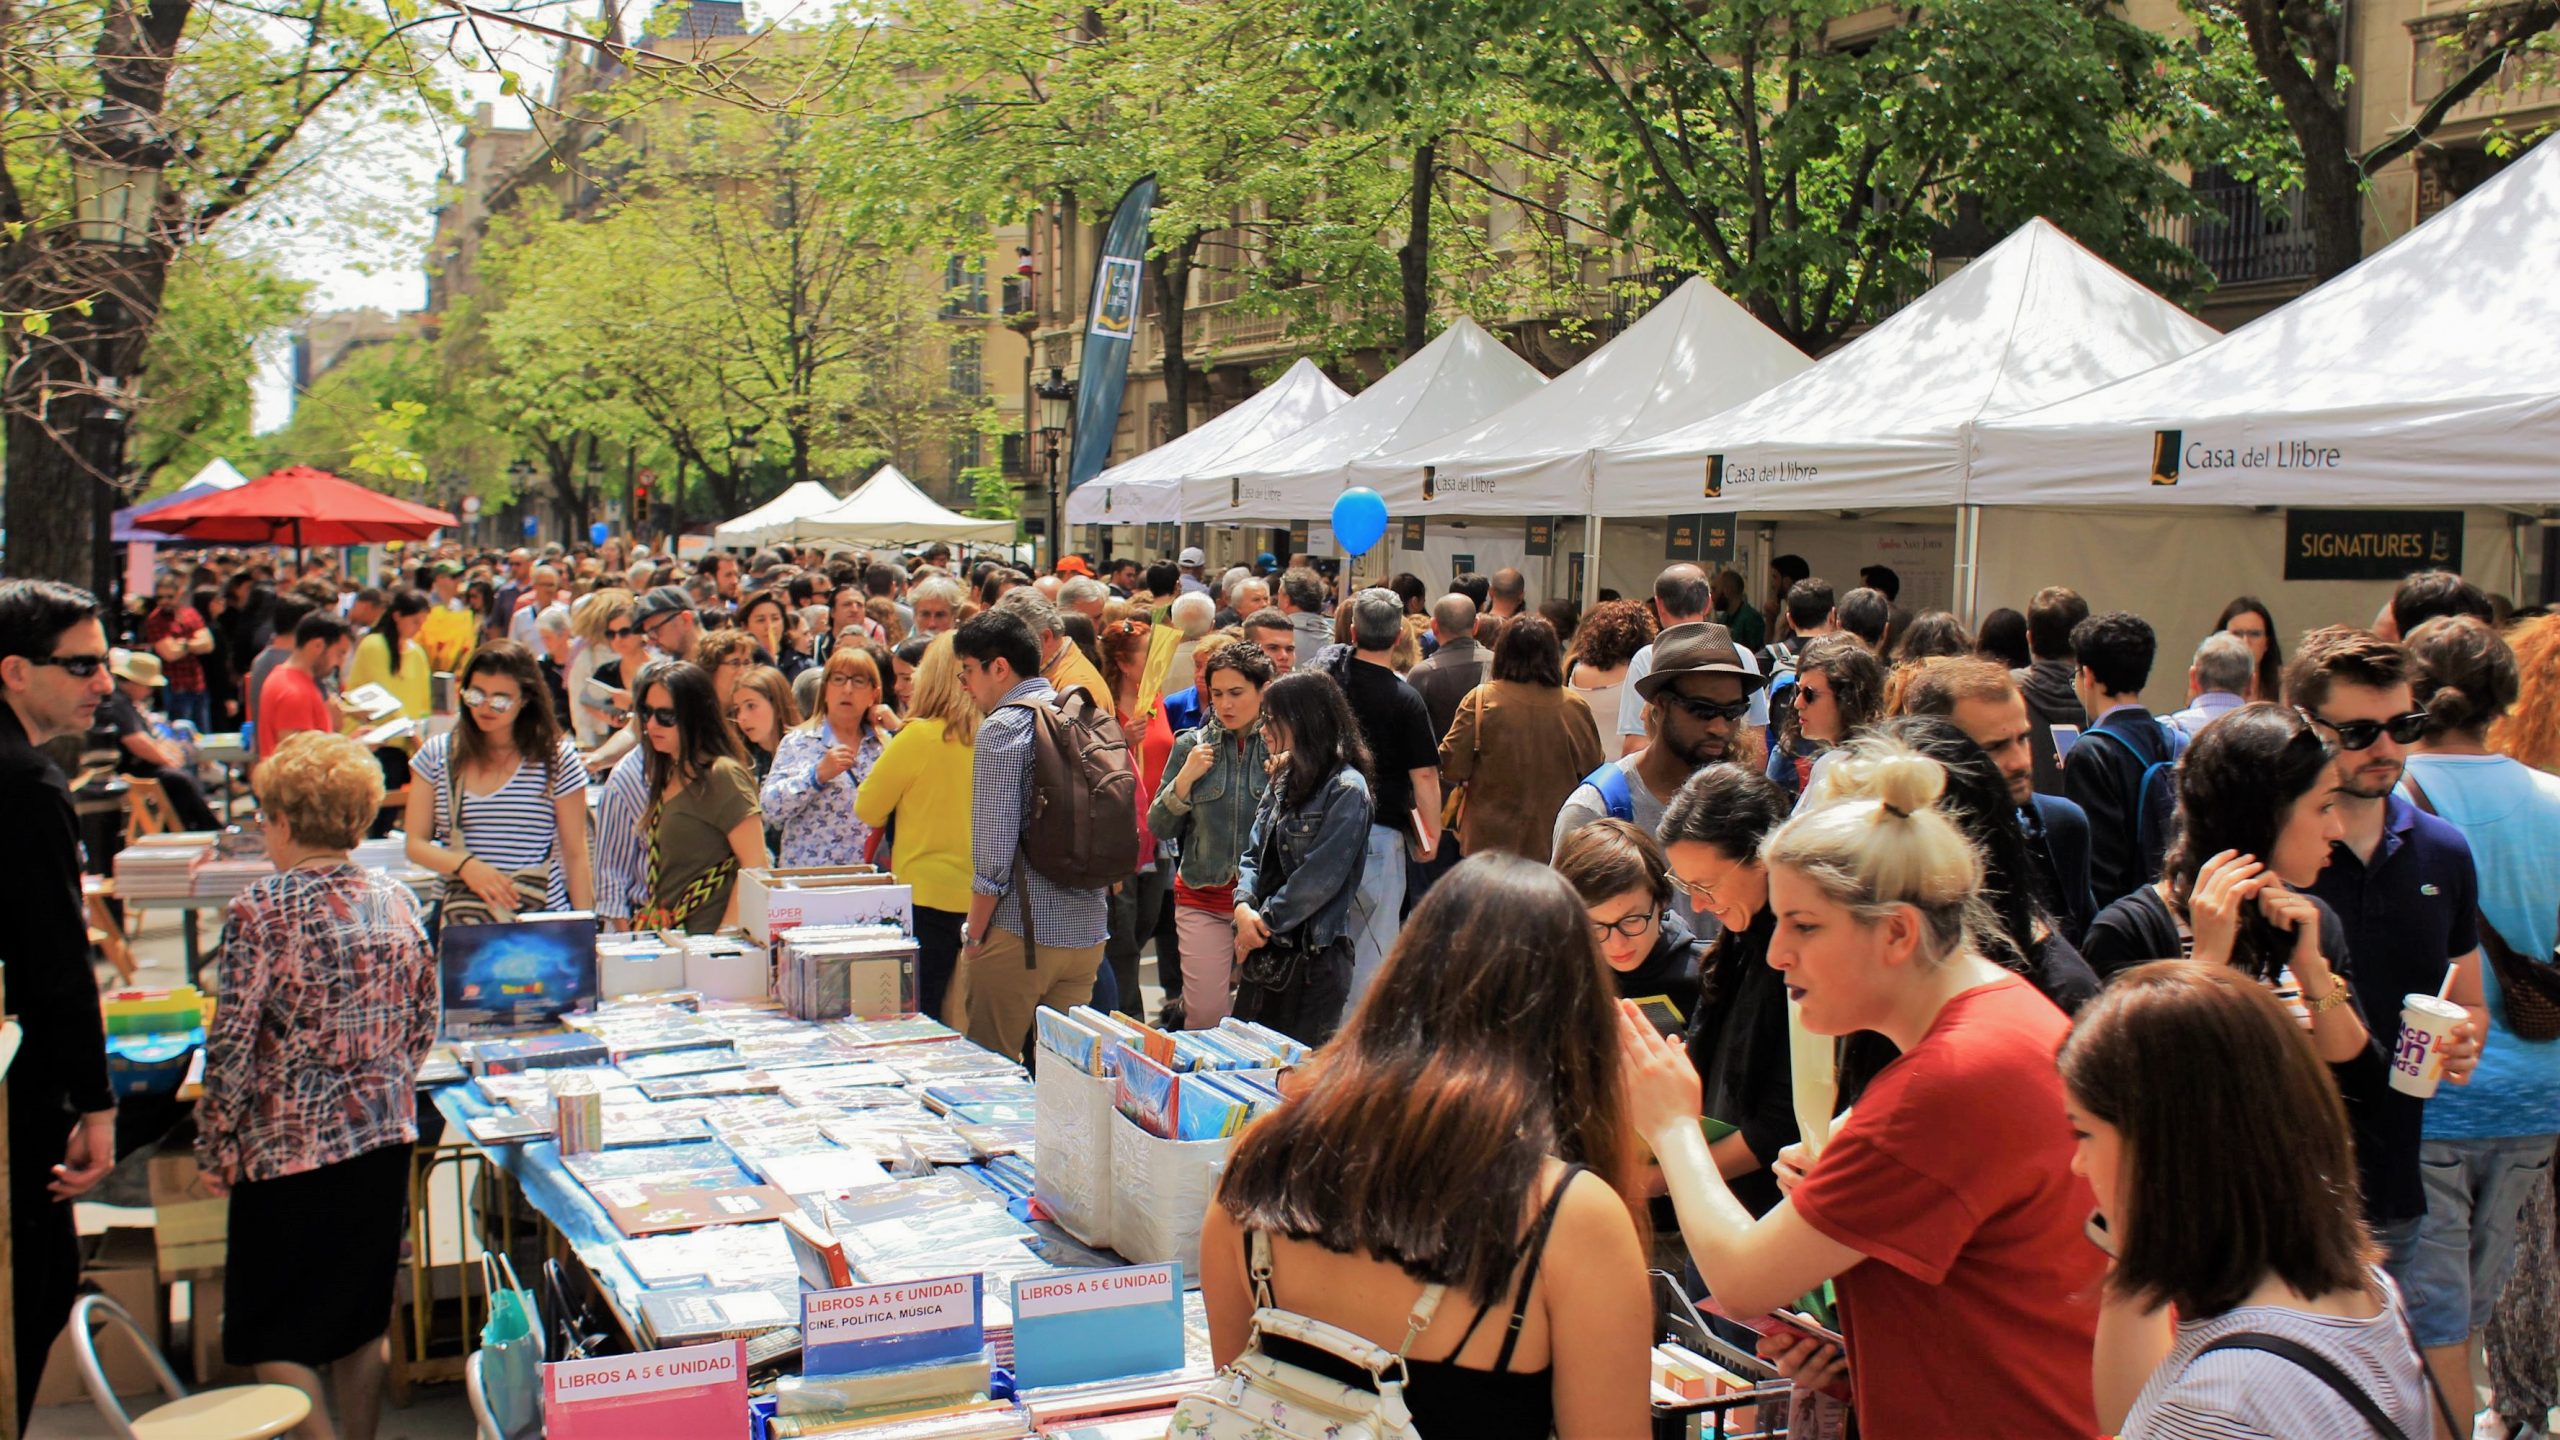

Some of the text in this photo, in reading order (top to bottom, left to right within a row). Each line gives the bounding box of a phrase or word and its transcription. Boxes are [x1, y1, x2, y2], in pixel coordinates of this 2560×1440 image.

[2185, 440, 2341, 469] Casa del Llibre
[1435, 474, 1496, 493] Casa del Llibre
[1725, 461, 1818, 485] Casa del Llibre
[2301, 532, 2423, 558] SIGNATURES
[808, 1282, 968, 1313] LIBROS A 5 € UNIDAD.
[1021, 1273, 1171, 1301] LIBROS A 5 € UNIDAD.
[808, 1304, 943, 1331] CINE, POLÍTICA, MÚSICA
[558, 1356, 736, 1389] LIBROS A 5 € UNIDAD.
